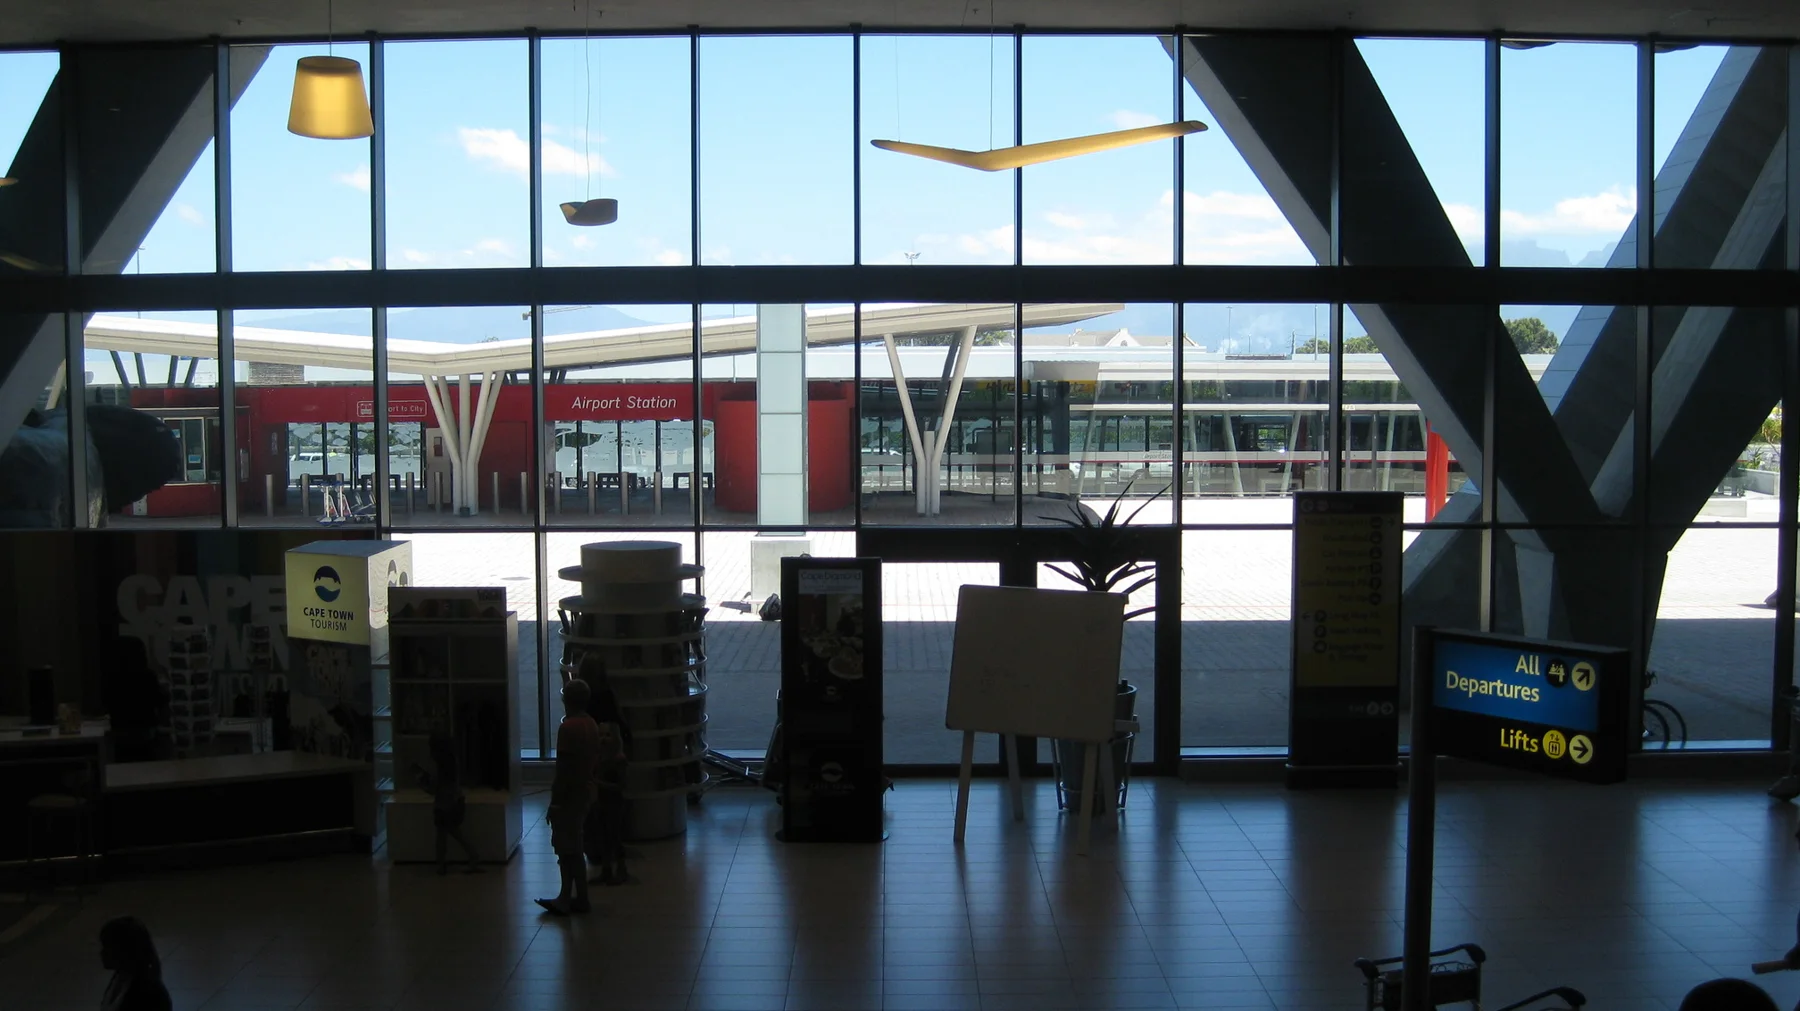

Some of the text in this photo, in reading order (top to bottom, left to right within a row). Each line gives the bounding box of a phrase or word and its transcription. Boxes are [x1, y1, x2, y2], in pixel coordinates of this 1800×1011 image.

[401, 404, 408, 412] to
[410, 404, 424, 413] City
[571, 395, 677, 412] Airport Station
[303, 607, 354, 621] CAPE TOWN
[310, 618, 347, 632] TOURISM
[1515, 655, 1541, 676] All
[1446, 671, 1540, 703] Departures
[1501, 728, 1539, 754] Lifts
